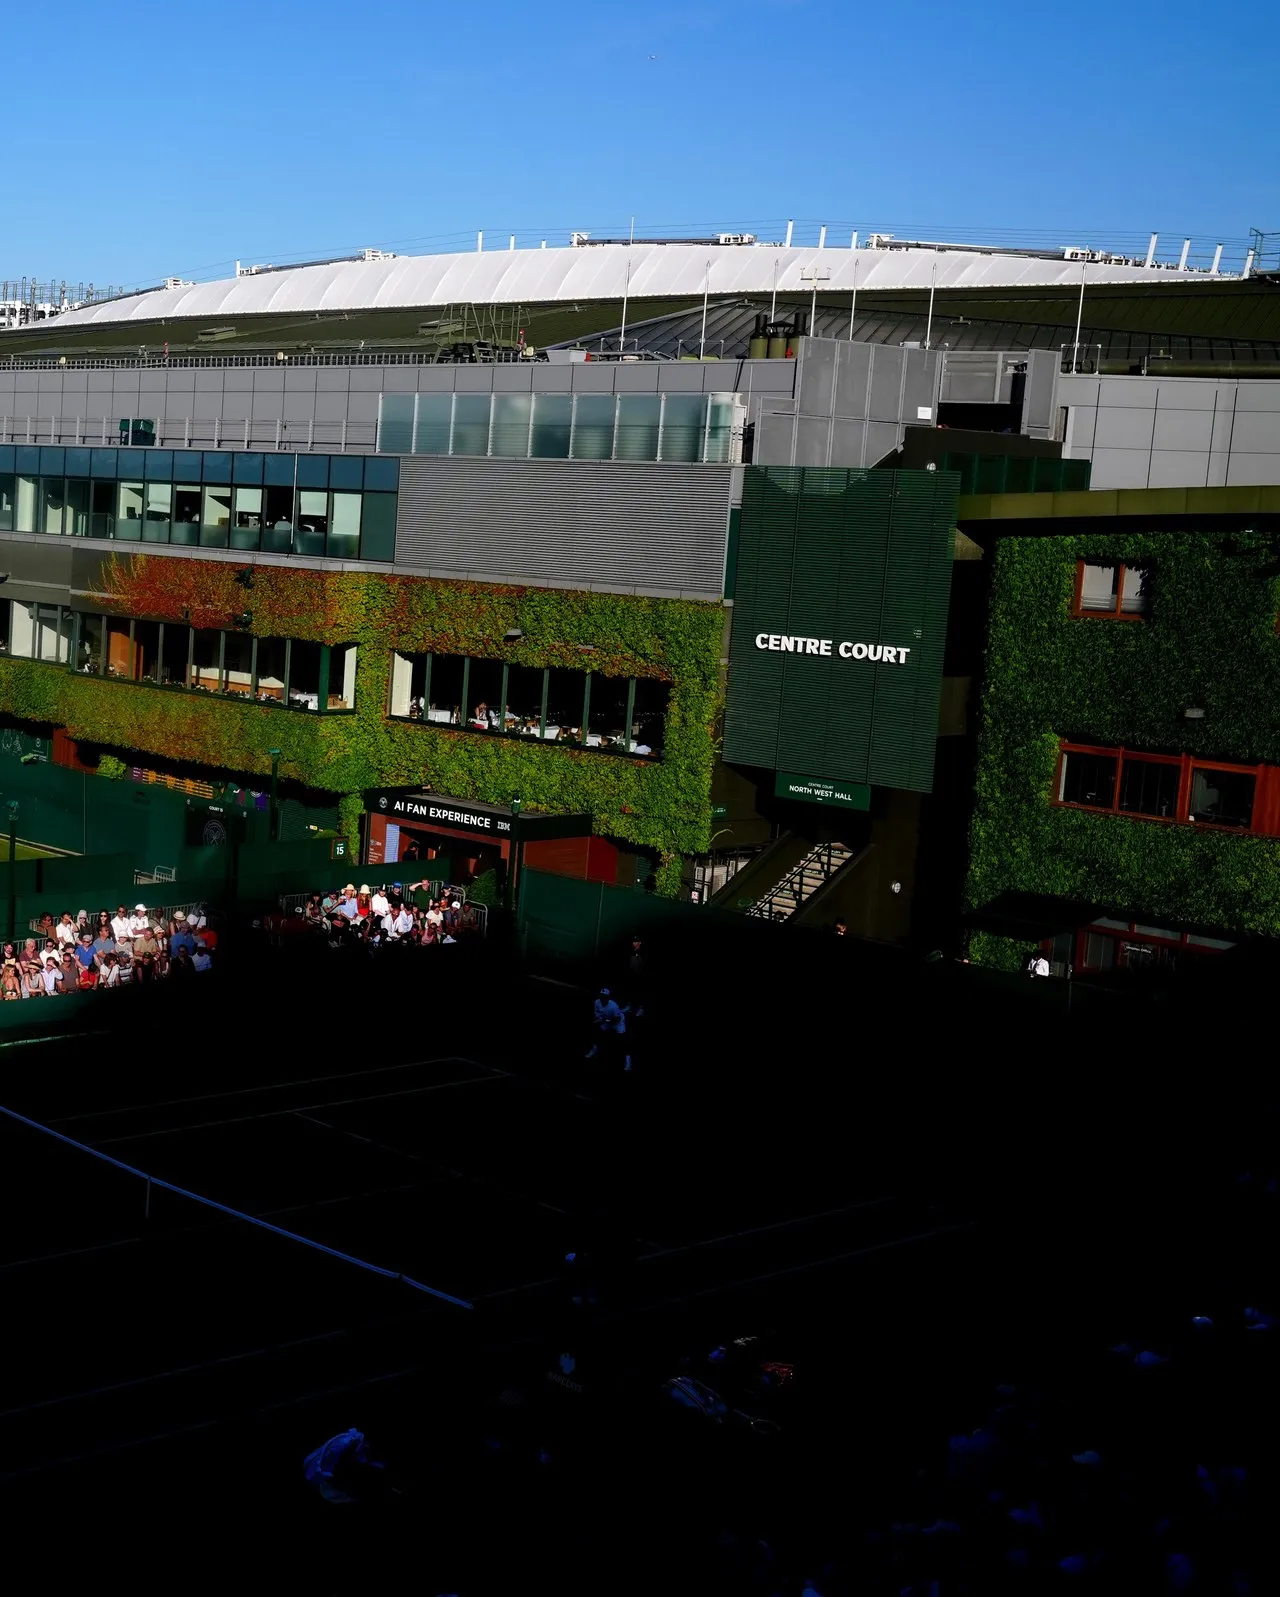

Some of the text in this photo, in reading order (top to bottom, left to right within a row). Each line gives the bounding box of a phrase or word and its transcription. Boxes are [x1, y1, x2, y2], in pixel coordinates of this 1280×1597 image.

[755, 633, 911, 664] CENTRE COURT
[789, 784, 852, 801] NORTH WEST HALL
[394, 800, 491, 829] AI FAN EXPERIENCE
[497, 821, 511, 832] IBM
[336, 846, 344, 855] 15
